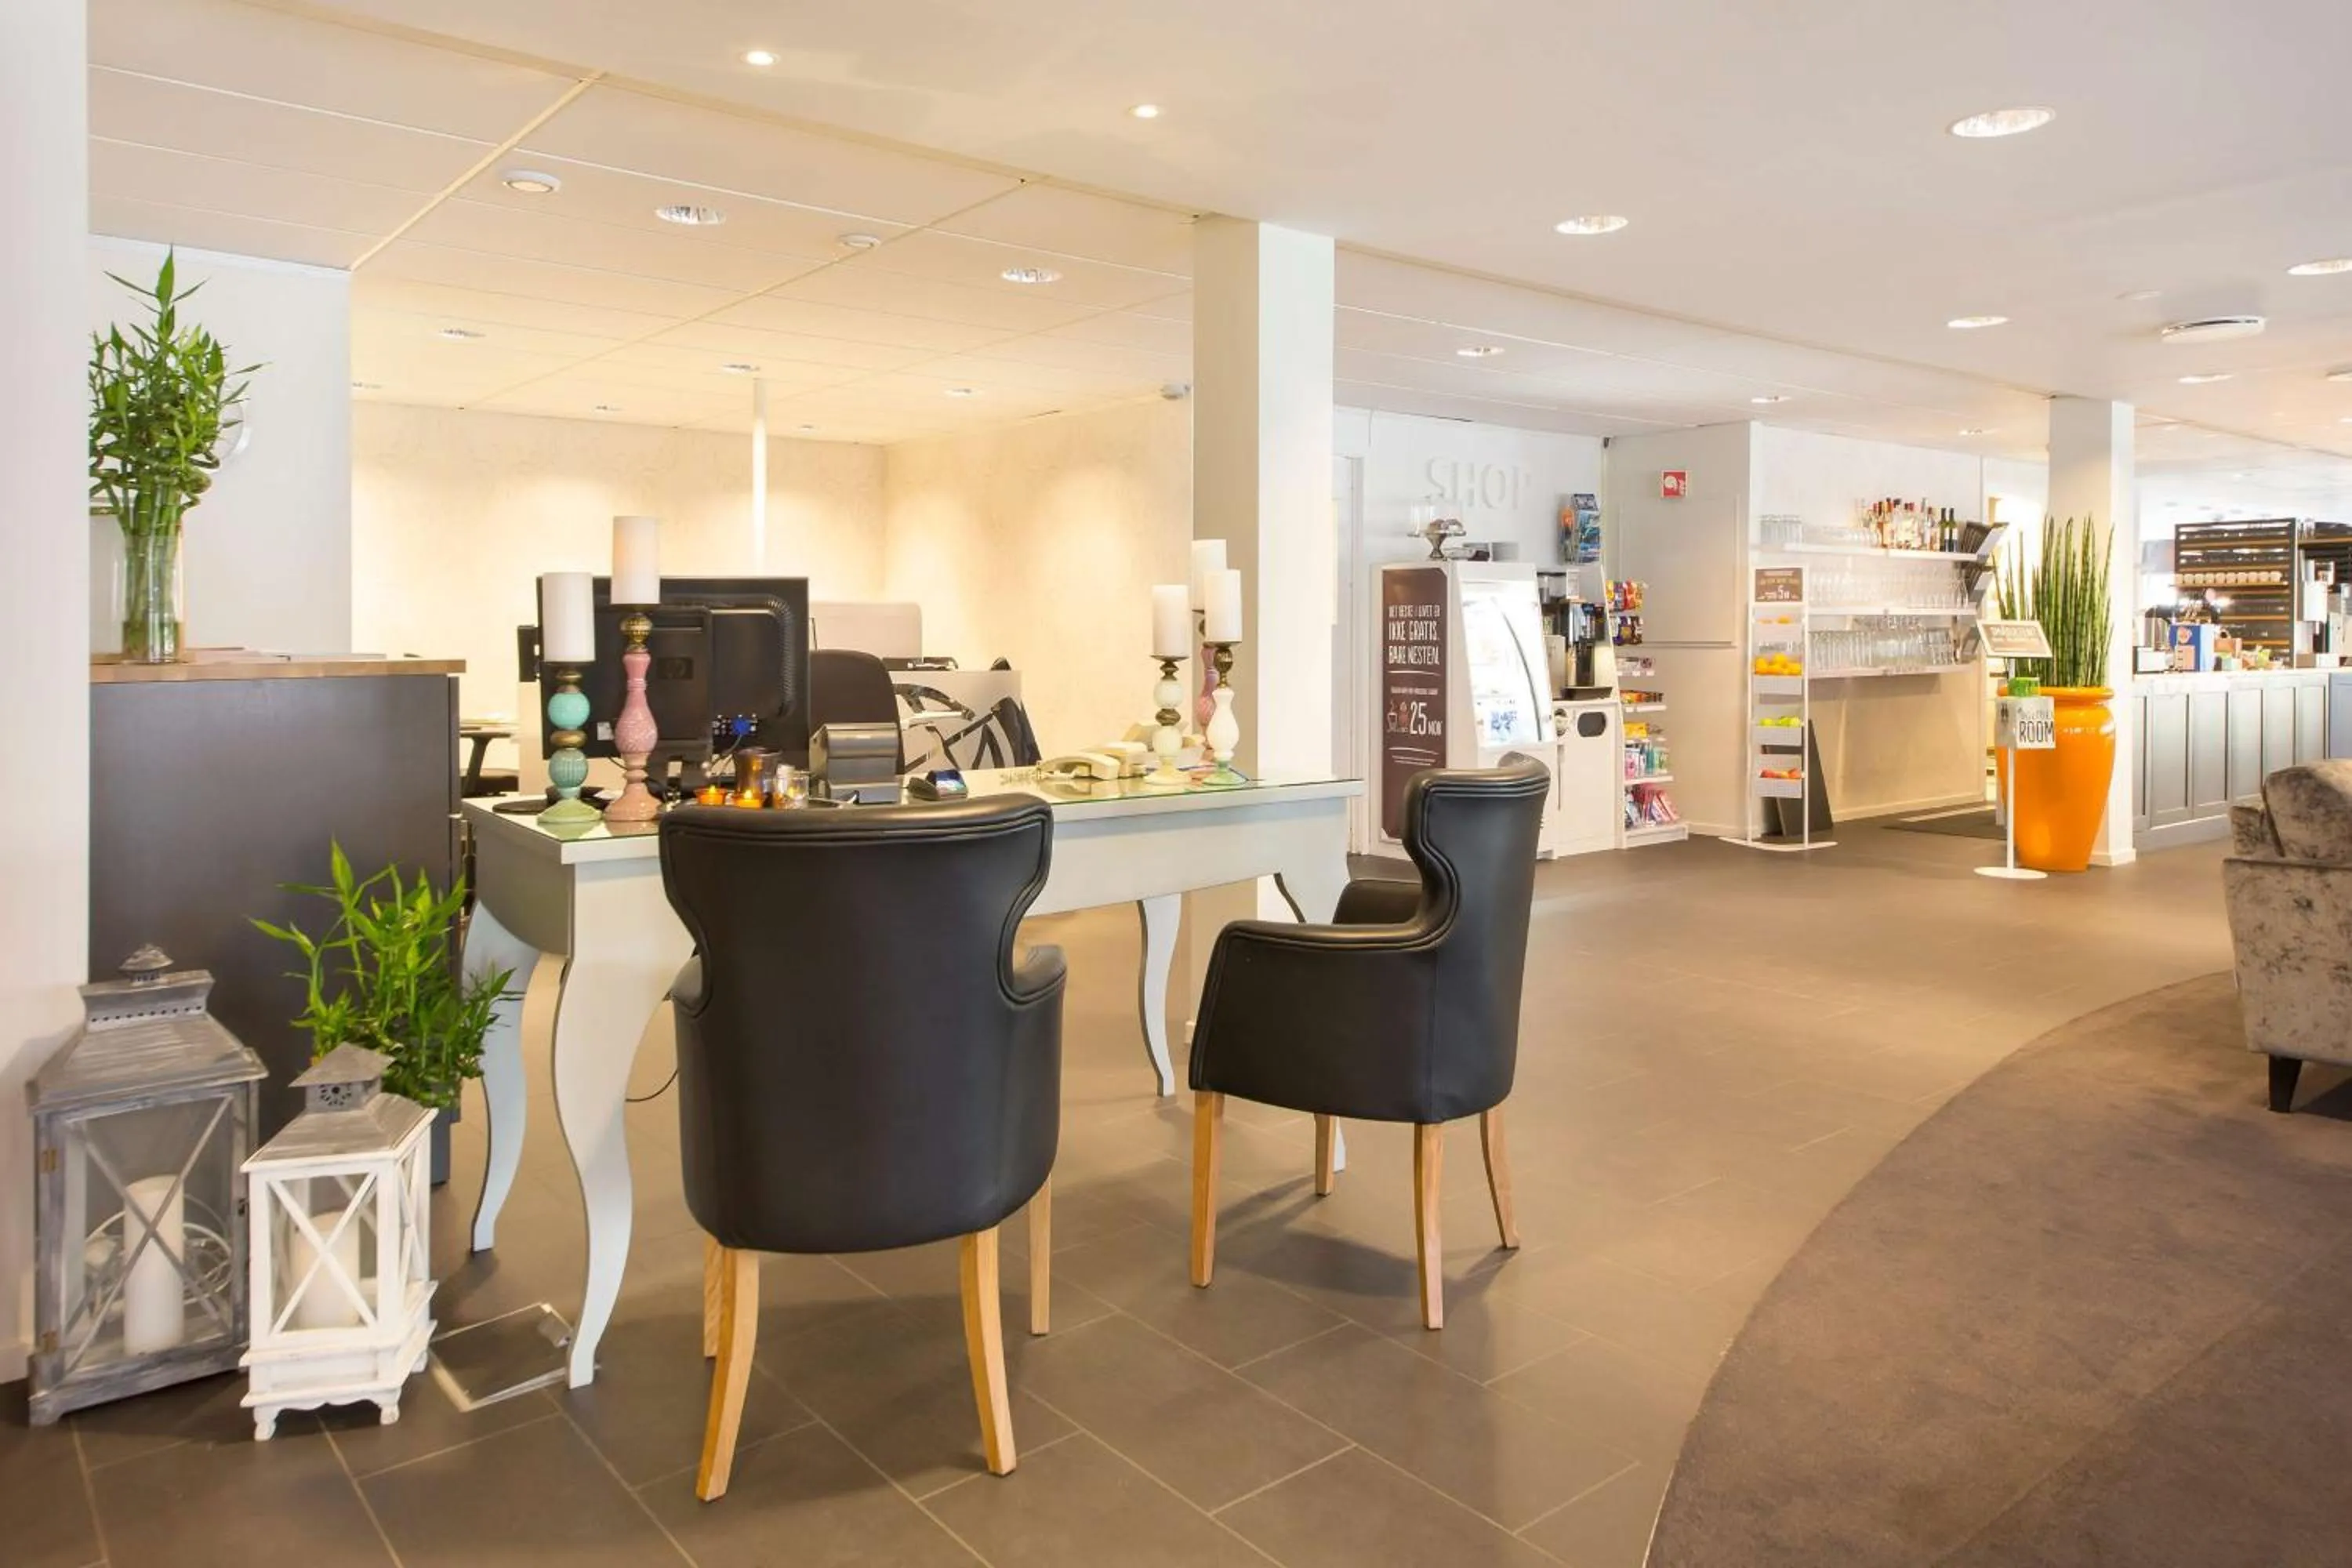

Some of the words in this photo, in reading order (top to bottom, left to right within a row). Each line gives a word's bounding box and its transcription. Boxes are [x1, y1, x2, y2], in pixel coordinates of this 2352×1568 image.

[1425, 456, 1531, 510] SHOP
[1388, 621, 1406, 641] IKKE
[1410, 701, 1427, 735] 25
[2019, 720, 2055, 743] ROOM
